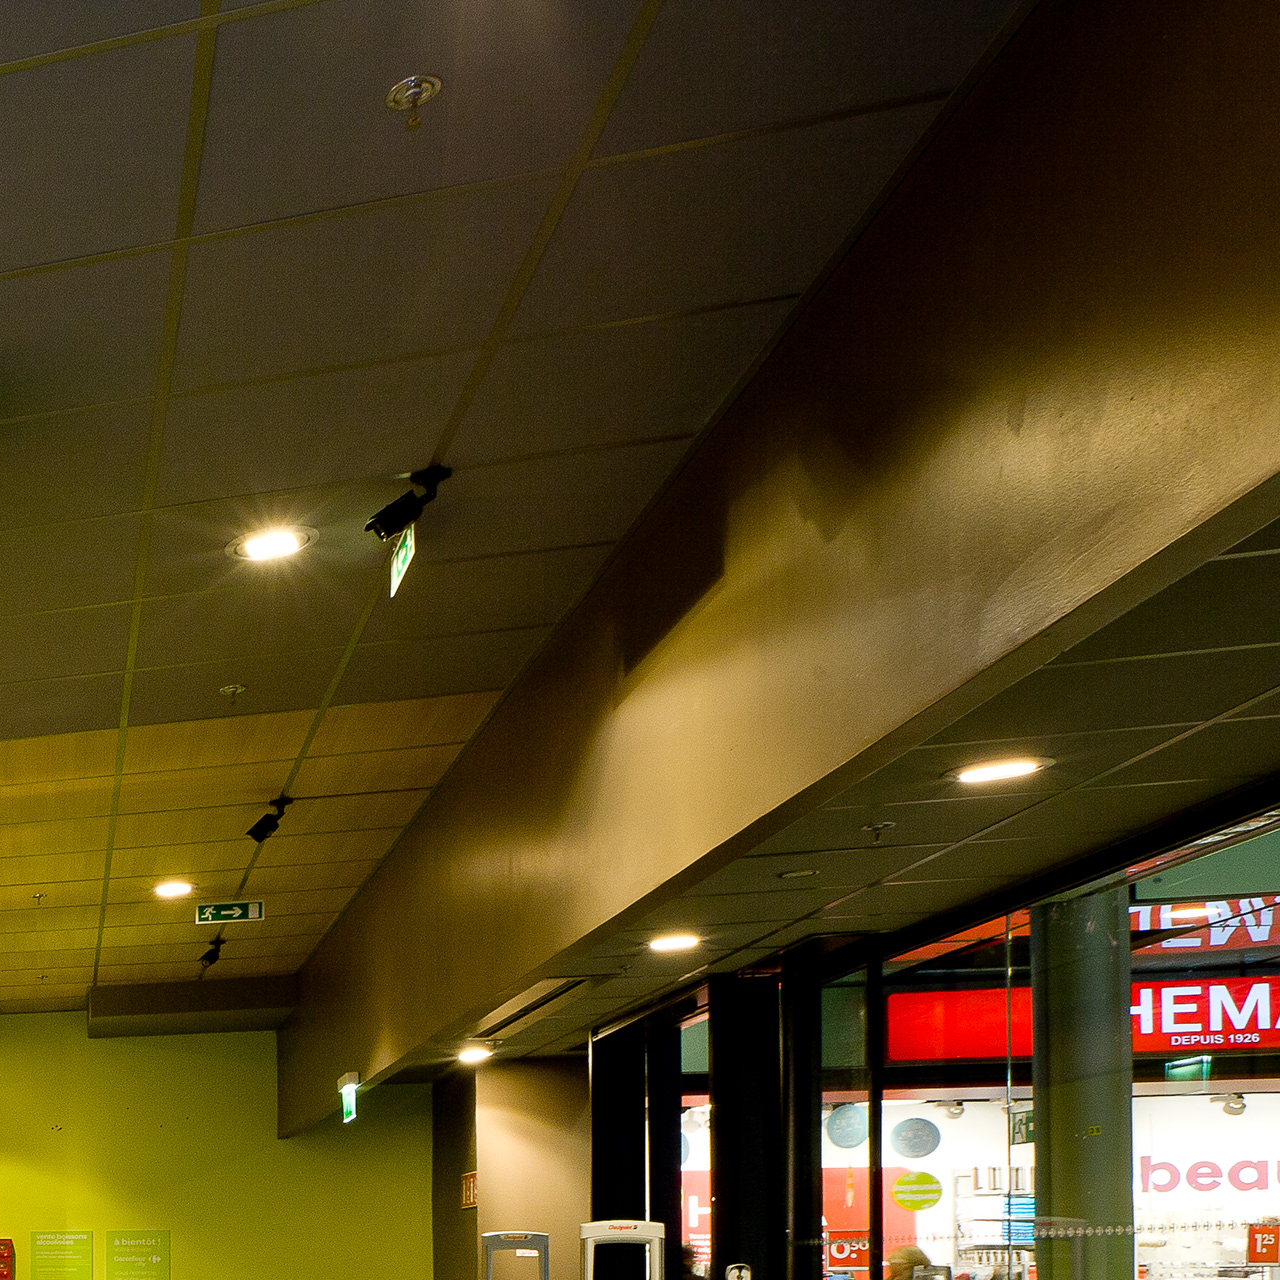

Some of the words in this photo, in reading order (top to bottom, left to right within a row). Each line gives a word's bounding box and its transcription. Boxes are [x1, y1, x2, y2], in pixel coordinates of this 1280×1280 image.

[1129, 982, 1280, 1034] HEM
[1170, 1034, 1224, 1046] DEPUIS
[1228, 1033, 1260, 1043] 1926
[1140, 1156, 1280, 1192] bea
